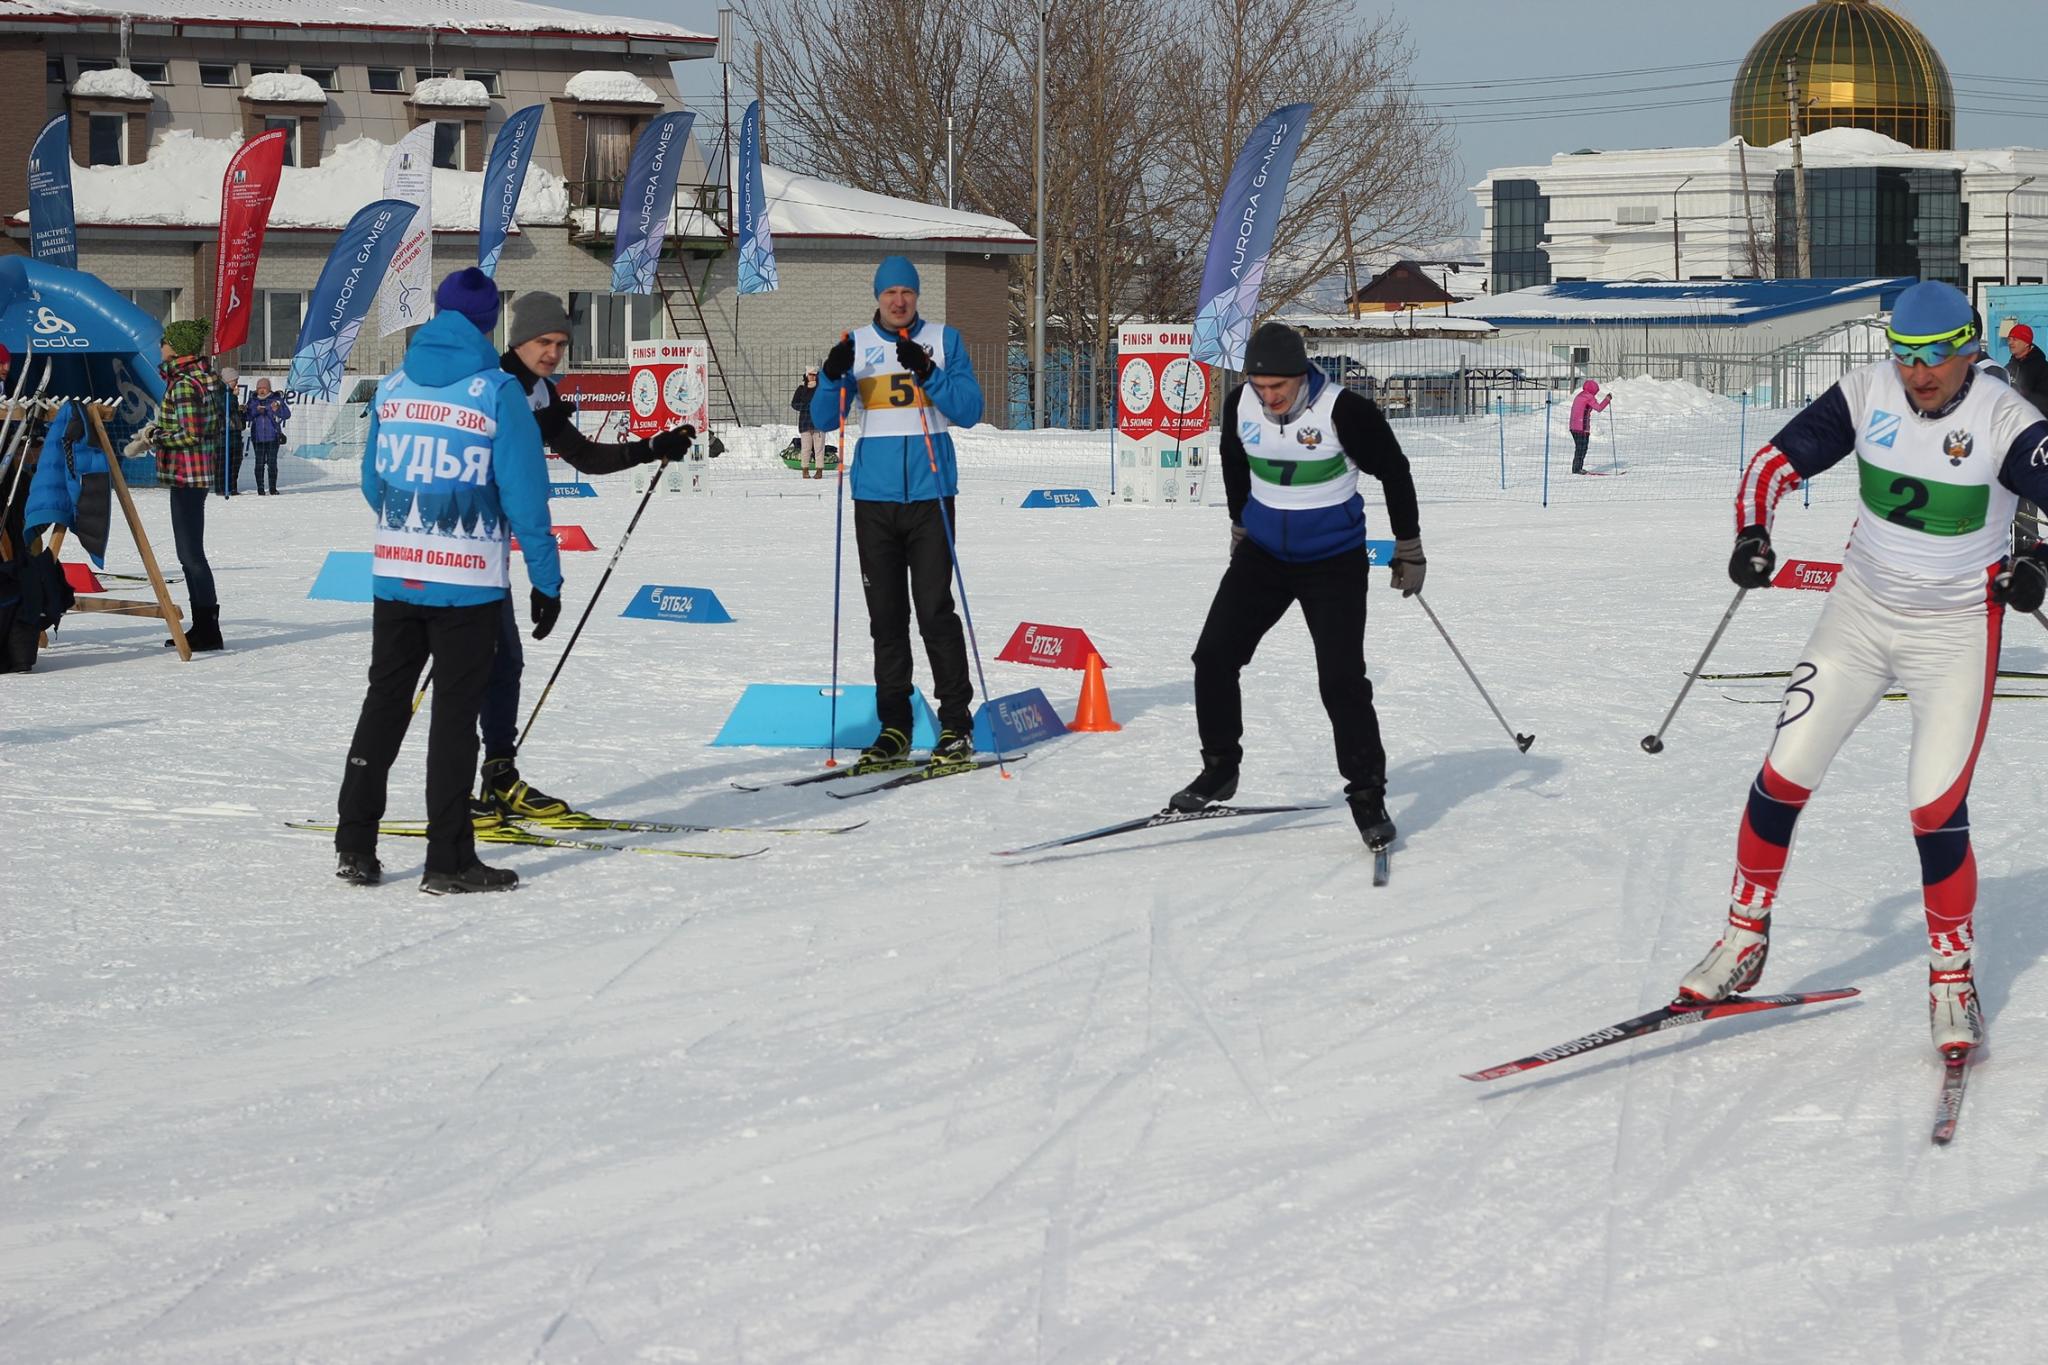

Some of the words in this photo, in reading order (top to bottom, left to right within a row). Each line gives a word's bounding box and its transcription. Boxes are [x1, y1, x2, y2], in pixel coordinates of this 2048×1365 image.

[507, 120, 528, 170] GAMES
[639, 174, 660, 235] AURORA
[652, 121, 675, 172] GAMES
[500, 172, 516, 235] AURORA
[745, 171, 755, 232] AURORA
[1230, 193, 1261, 279] AURORA
[389, 229, 426, 269] СПОРТИВНЫХ
[329, 266, 363, 332] AURORA
[356, 210, 392, 265] GAMES
[32, 336, 90, 348] odlo
[1122, 333, 1153, 346] FINISH
[1159, 333, 1192, 345] ФИНИ
[632, 347, 656, 359] FINISH
[468, 377, 487, 397] 8
[560, 391, 627, 403] СПОРТИВНОЙ
[888, 373, 915, 408] 5
[379, 402, 401, 421] БУ
[406, 402, 451, 422] СШОР
[375, 433, 492, 486] СУДЬЯ
[1267, 459, 1298, 487] 7
[554, 486, 581, 496] ВТБ24
[1053, 494, 1081, 504] ВТБ24
[1886, 477, 1930, 531] 2
[426, 550, 487, 570] ОБЛАСТЬ
[1802, 569, 1833, 584] ВТБ24
[659, 596, 693, 613] ВТБ24
[1031, 635, 1064, 657] ВТБ24
[1010, 703, 1044, 734] ВТБ24
